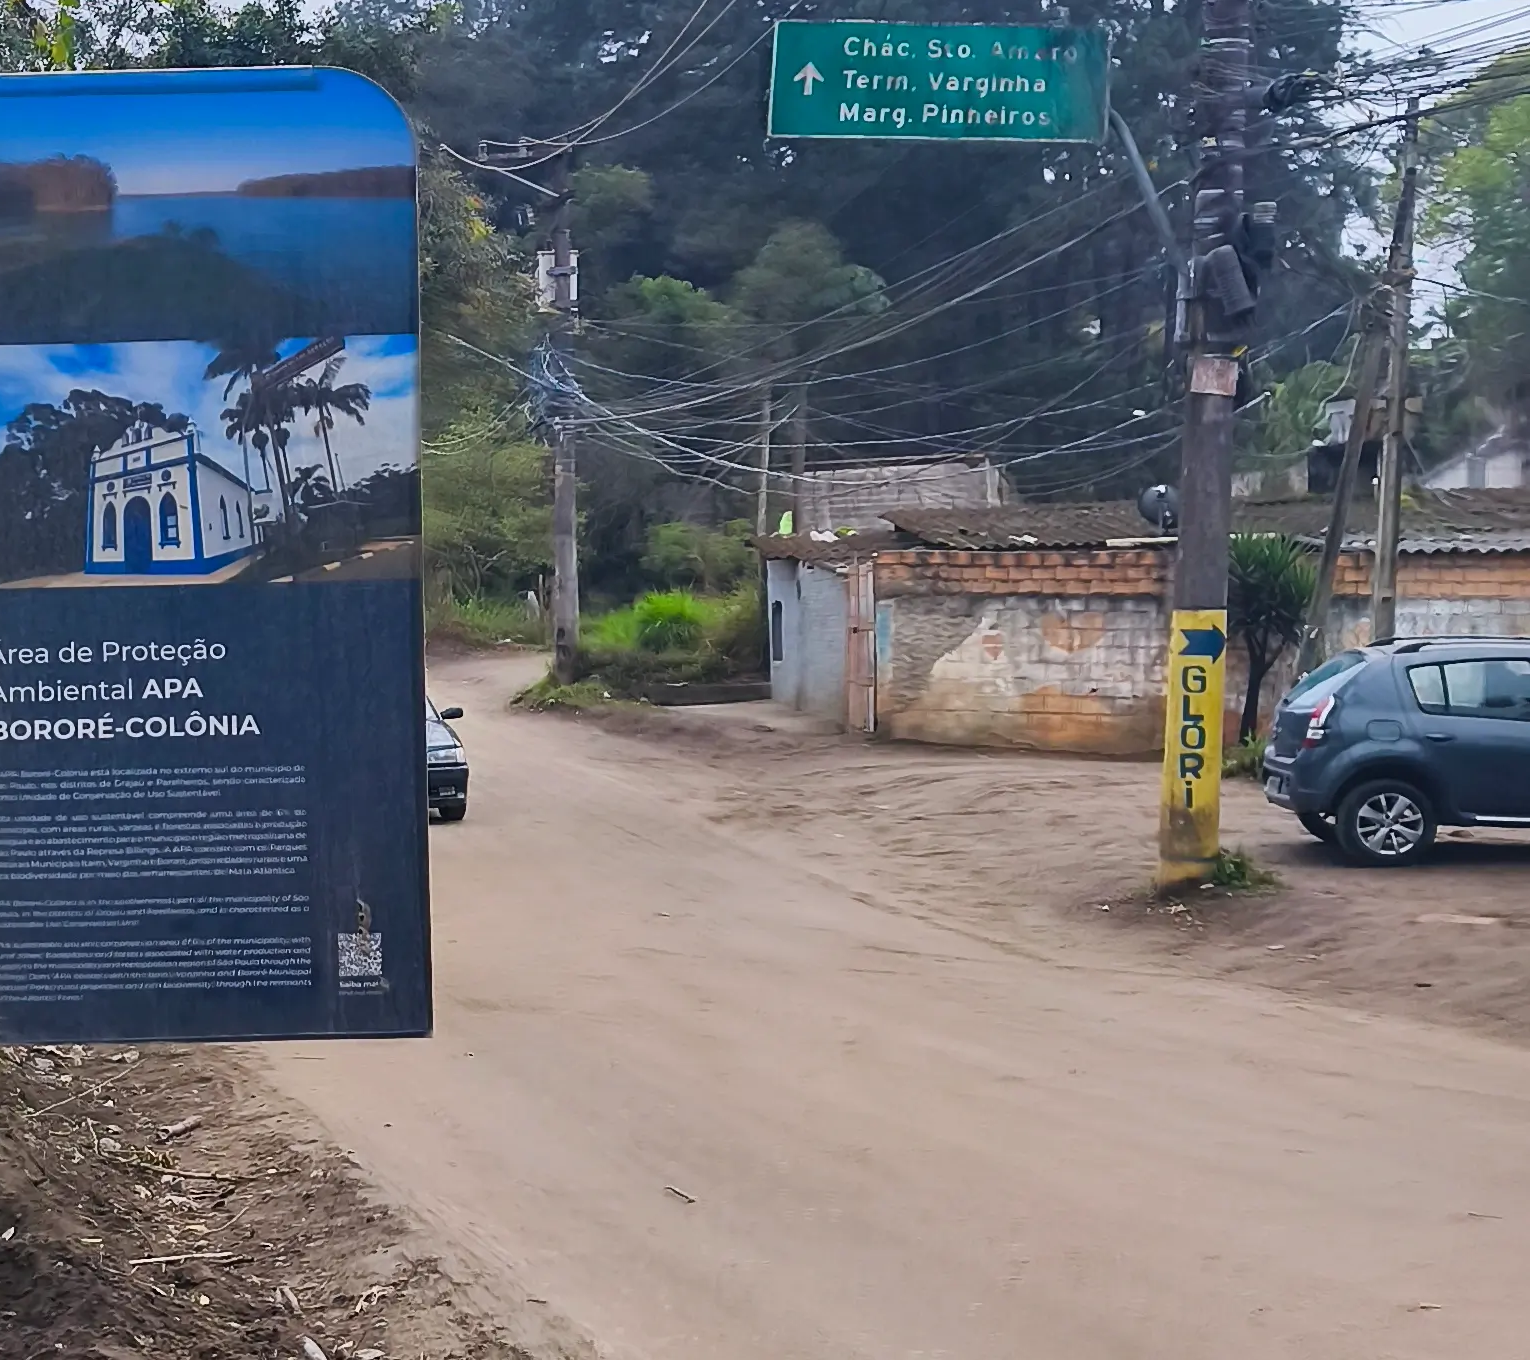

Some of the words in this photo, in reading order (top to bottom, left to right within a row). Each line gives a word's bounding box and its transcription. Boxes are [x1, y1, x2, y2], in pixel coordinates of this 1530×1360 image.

[842, 69, 917, 92] Term.
[928, 71, 1046, 99] Varginha
[839, 102, 913, 129] Marg.
[922, 102, 1052, 126] Pinheiros
[58, 639, 94, 663] de
[102, 638, 226, 665] Proteção
[141, 676, 204, 700] APA
[60, 781, 97, 789] distritos
